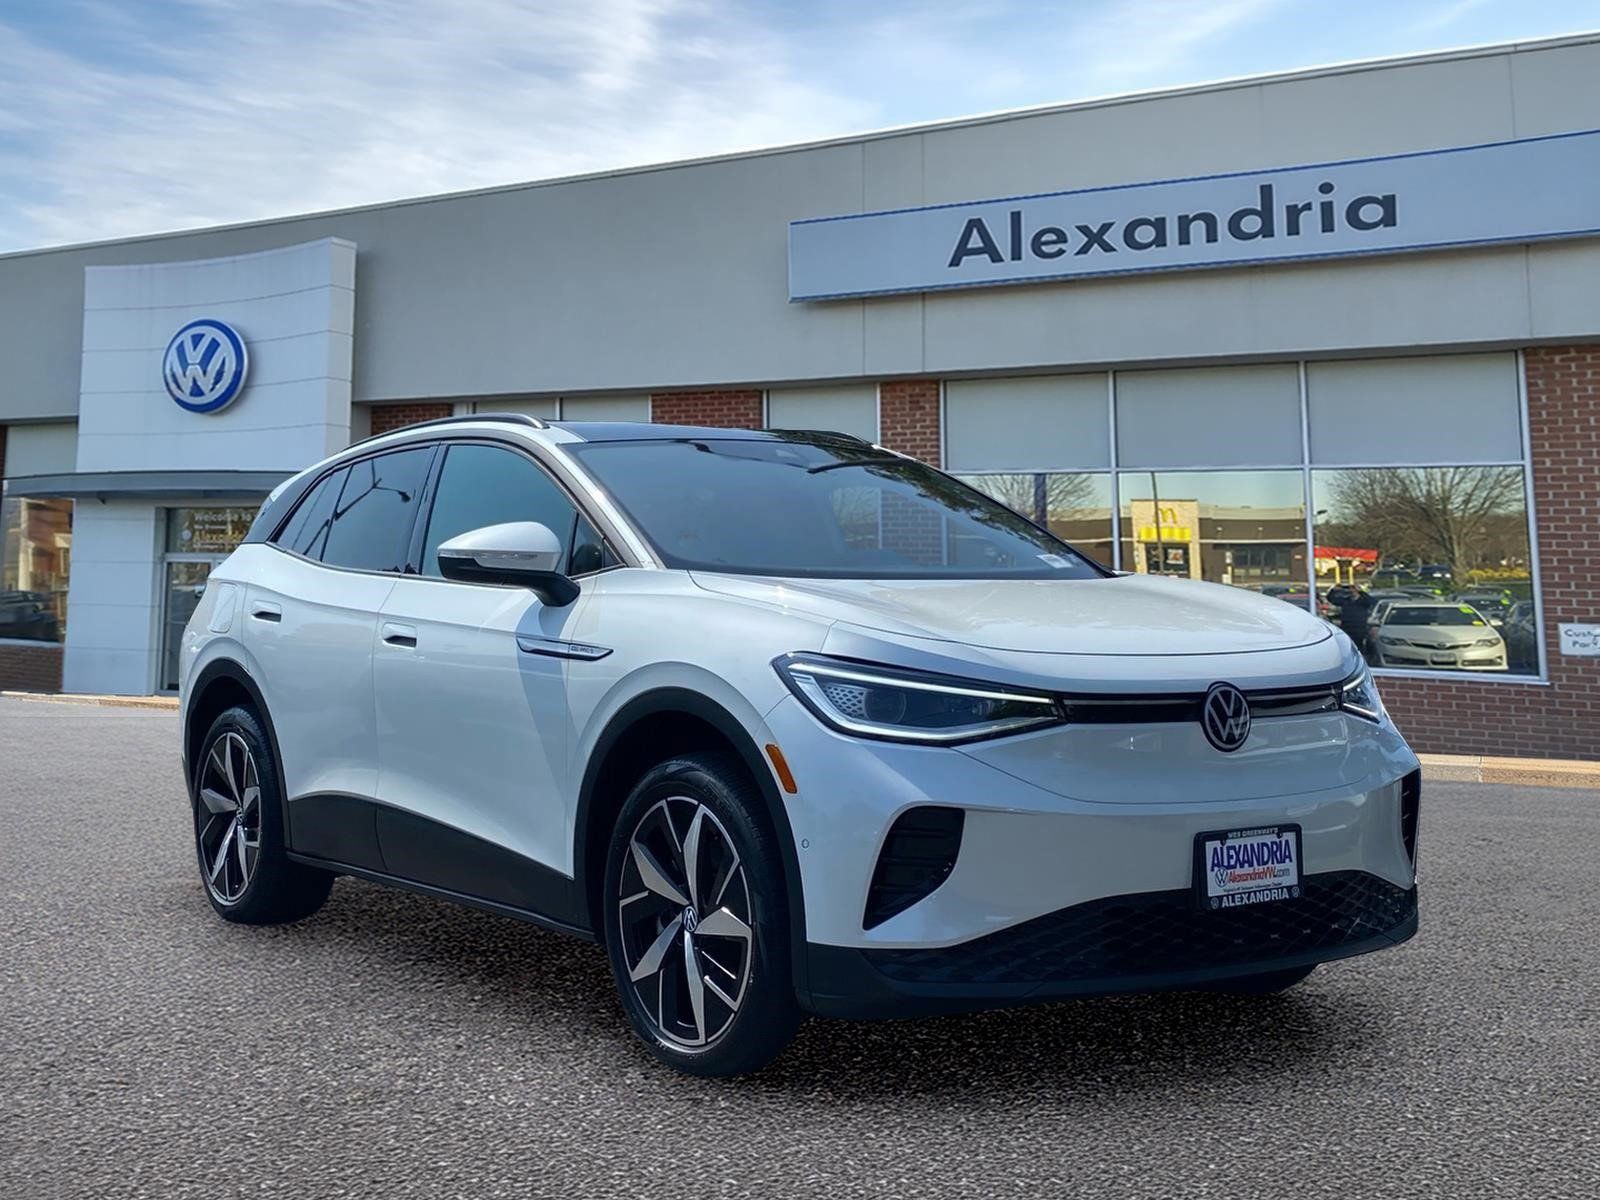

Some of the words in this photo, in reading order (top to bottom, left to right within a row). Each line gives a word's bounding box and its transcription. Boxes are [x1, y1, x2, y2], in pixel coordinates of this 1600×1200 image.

[948, 182, 1398, 268] Alexandria
[164, 319, 246, 412] VW
[1204, 683, 1250, 751] VW
[1210, 839, 1293, 872] ALEXANDRIA
[1222, 888, 1289, 907] ALEXANDRIA
